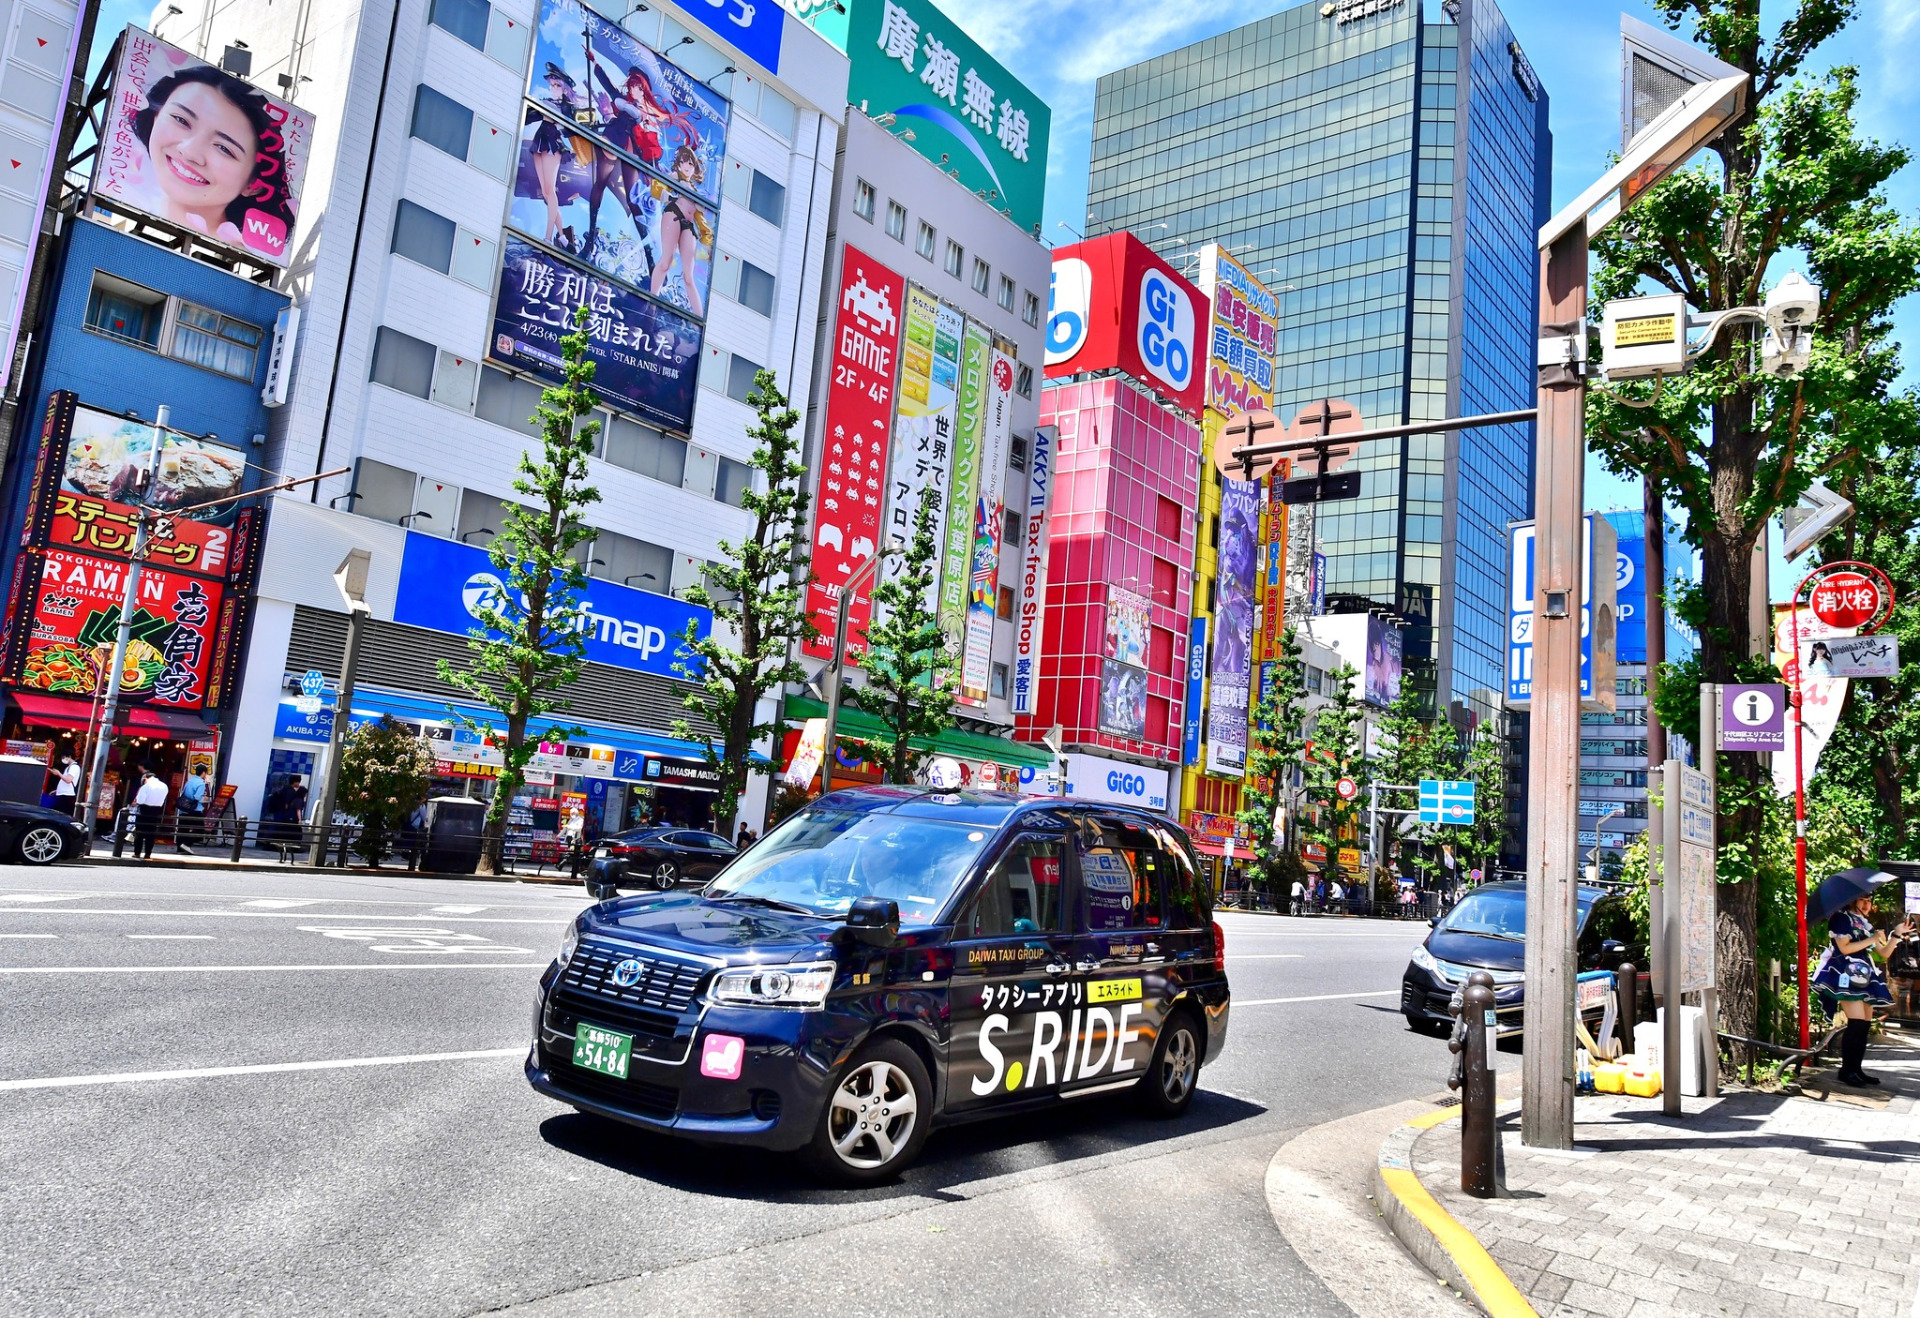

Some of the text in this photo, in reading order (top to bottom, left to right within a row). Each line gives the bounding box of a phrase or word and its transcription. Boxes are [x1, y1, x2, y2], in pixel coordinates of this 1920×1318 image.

[877, 0, 1032, 163] 廣瀬無線
[253, 101, 289, 203] ワクワク
[520, 259, 624, 320] 勝利は、
[1216, 284, 1275, 357] 激安販売
[1617, 318, 1673, 330] 防犯カメラ作動中
[840, 324, 890, 378] GAME
[1213, 325, 1272, 393] 高額買取
[835, 364, 889, 405] 2F 4F
[1032, 431, 1050, 491] AKKY
[46, 550, 122, 573] YOKOHAMA
[1022, 509, 1045, 598] Tax-free
[42, 559, 164, 601] RAMN
[1836, 578, 1867, 587] HYDRANT
[61, 584, 140, 606] ICHIKAKUA
[1817, 588, 1874, 613] 消火栓
[43, 606, 75, 617] RAMEN
[1017, 602, 1036, 656] Shop
[1190, 644, 1203, 681] GiGO
[303, 677, 322, 688] 437
[285, 725, 313, 735] AKIBA
[433, 728, 443, 738] 2F
[463, 732, 473, 743] 3F
[1723, 730, 1784, 738] 千代田区エリアマップ
[1106, 770, 1146, 797] GiGO
[1340, 783, 1352, 793] 50
[1149, 796, 1164, 807] 3号館
[968, 948, 1044, 963] DAIWA TAXI GROUP
[980, 982, 1134, 1010] タクシーアプリ エスライド
[584, 1042, 627, 1076] 54-84
[970, 1002, 1143, 1096] S.RIDE
